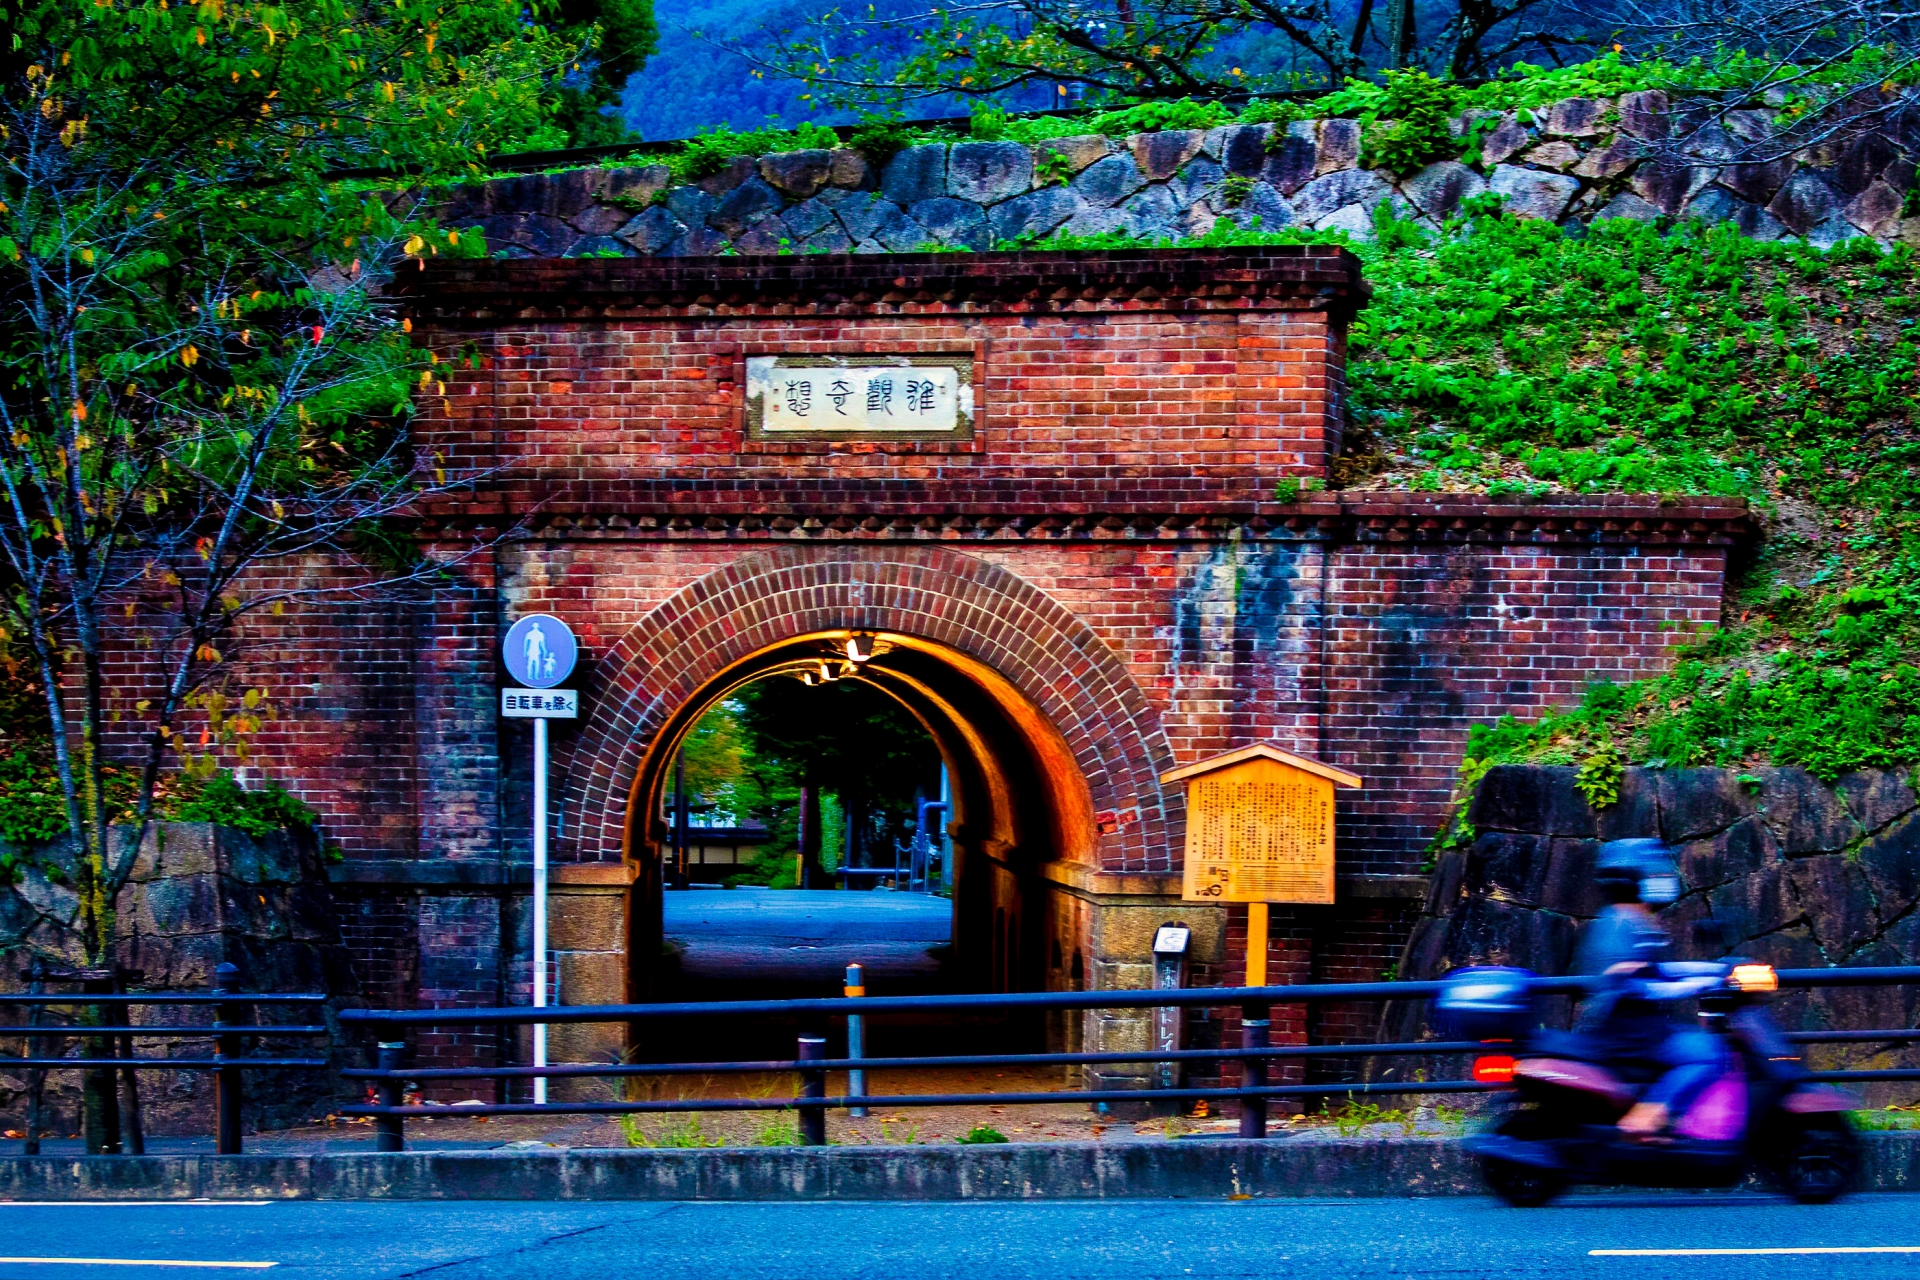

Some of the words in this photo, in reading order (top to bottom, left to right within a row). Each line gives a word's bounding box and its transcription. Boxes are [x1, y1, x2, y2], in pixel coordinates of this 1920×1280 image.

[505, 695, 574, 711] 自転車を除く
